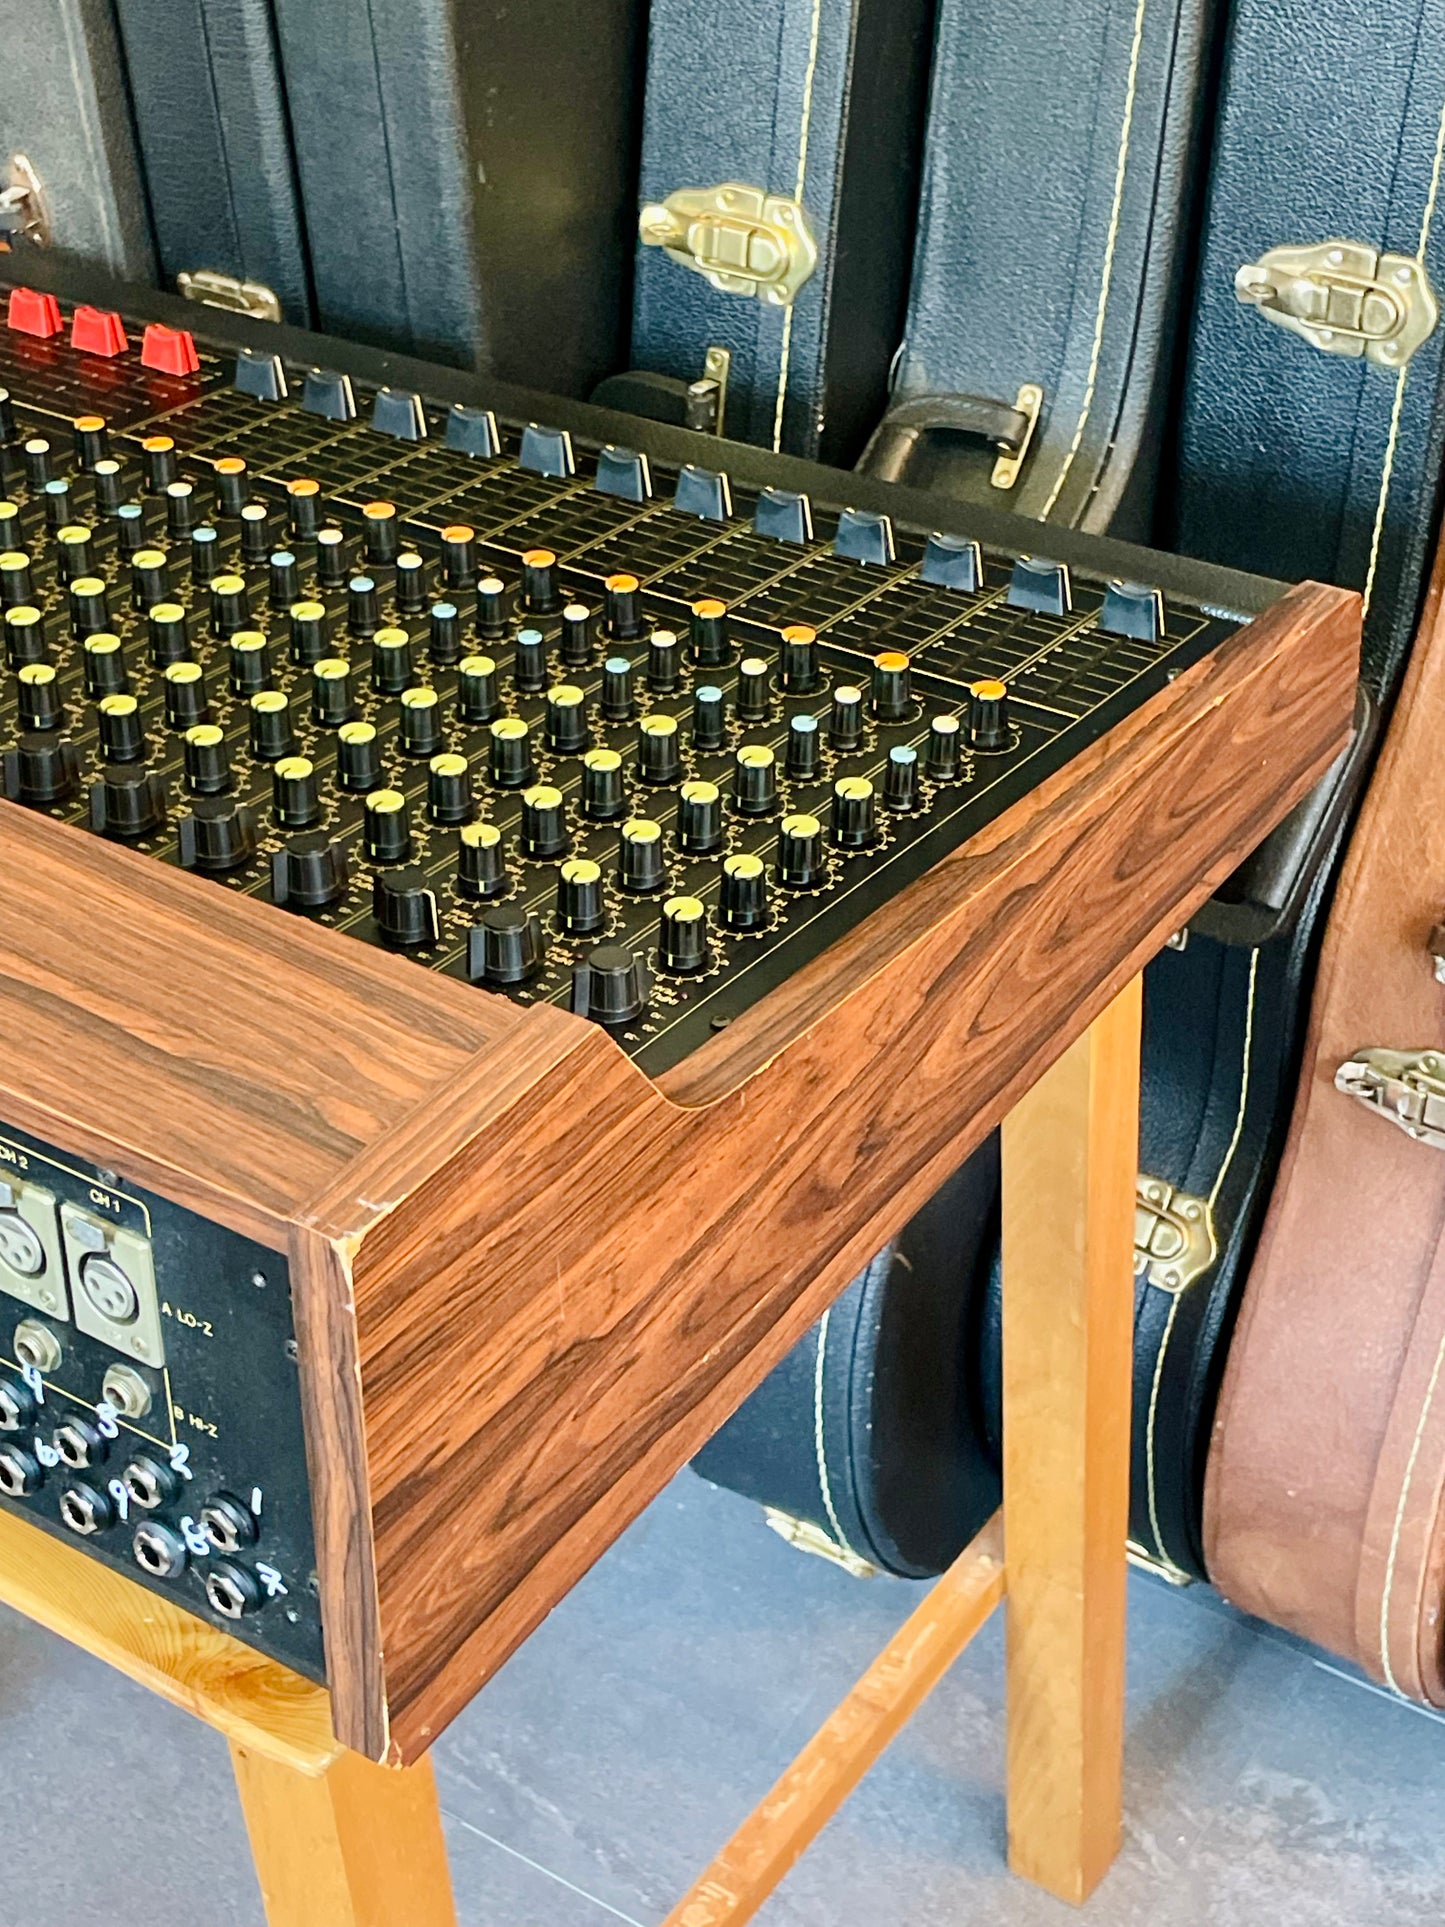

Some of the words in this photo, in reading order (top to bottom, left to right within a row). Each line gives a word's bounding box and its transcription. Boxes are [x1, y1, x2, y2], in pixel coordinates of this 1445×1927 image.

[161, 1301, 173, 1317] A
[173, 1405, 184, 1420] B
[169, 1443, 193, 1480] 2
[108, 1479, 129, 1520] 9
[251, 1486, 263, 1516] 1
[255, 1561, 289, 1597] 7
